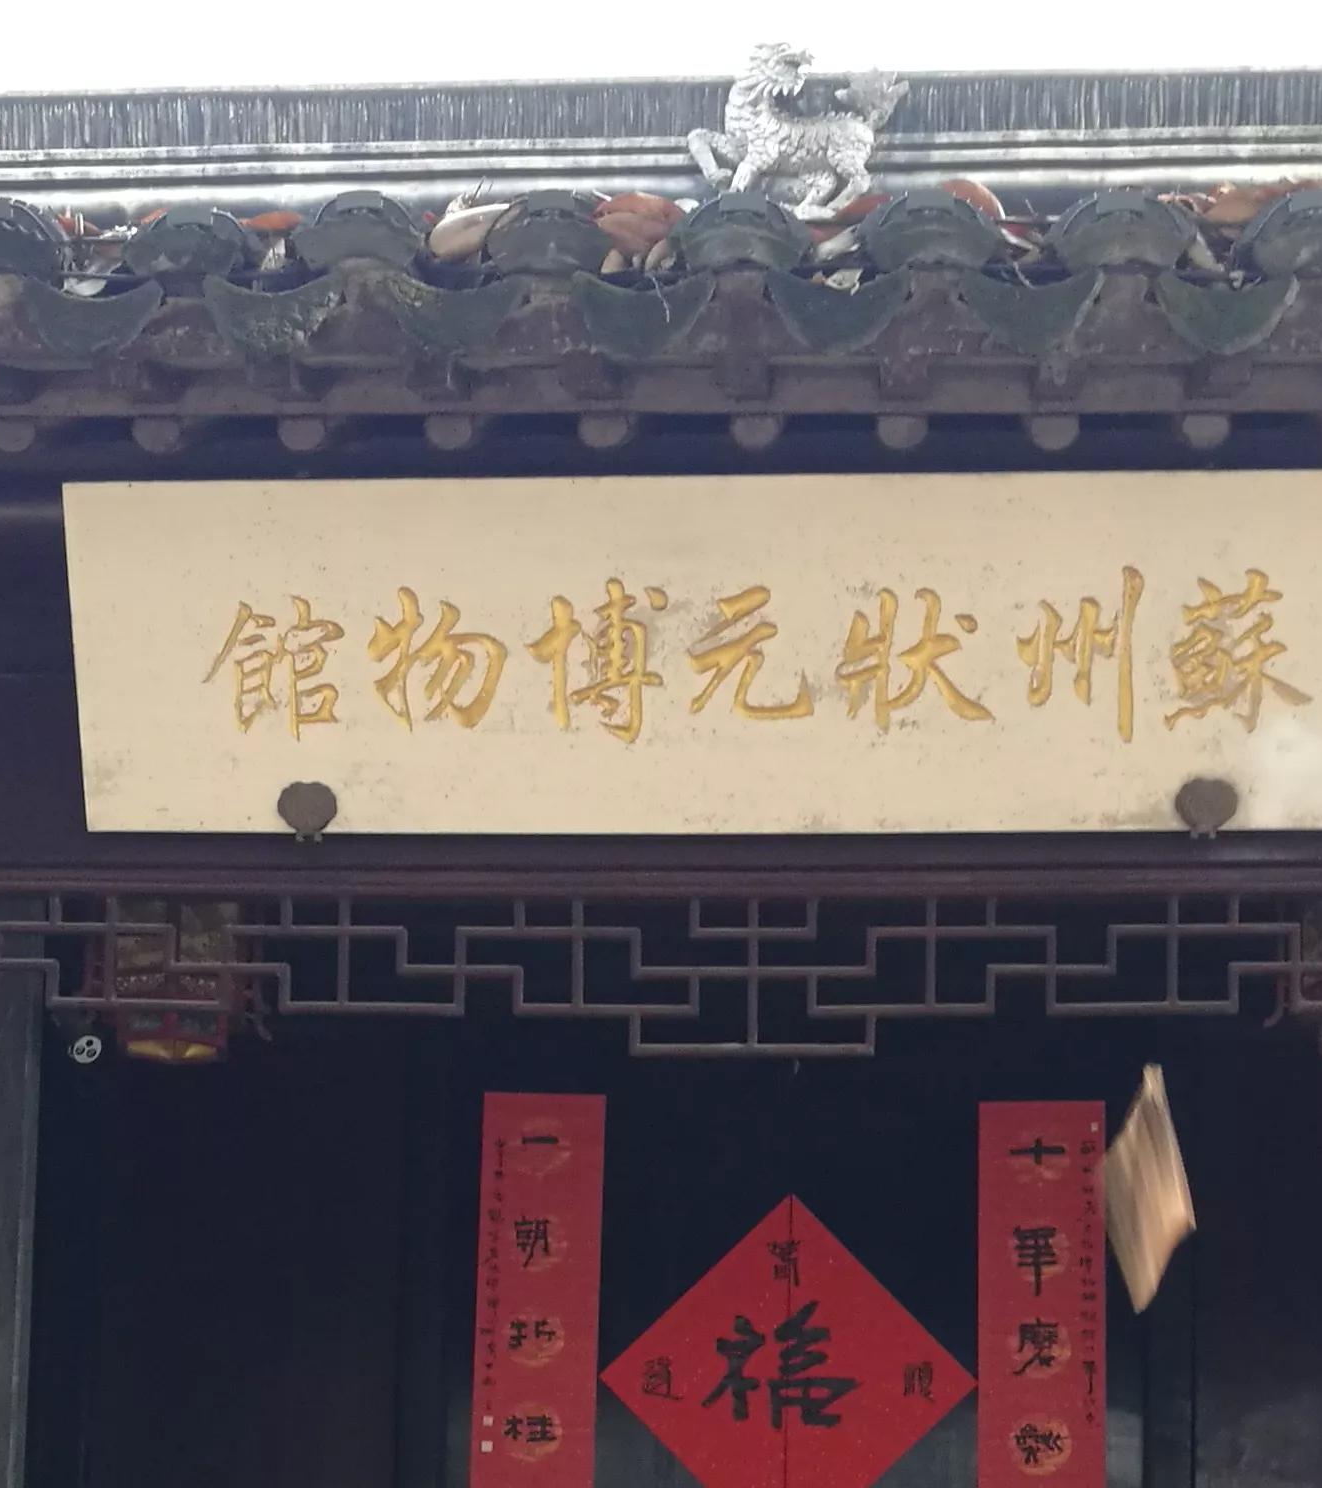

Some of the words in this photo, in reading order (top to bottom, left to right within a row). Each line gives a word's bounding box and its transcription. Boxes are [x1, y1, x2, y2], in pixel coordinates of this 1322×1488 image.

[202, 565, 1313, 745] 蘇州狀元博物館
[702, 1301, 863, 1430] 福
